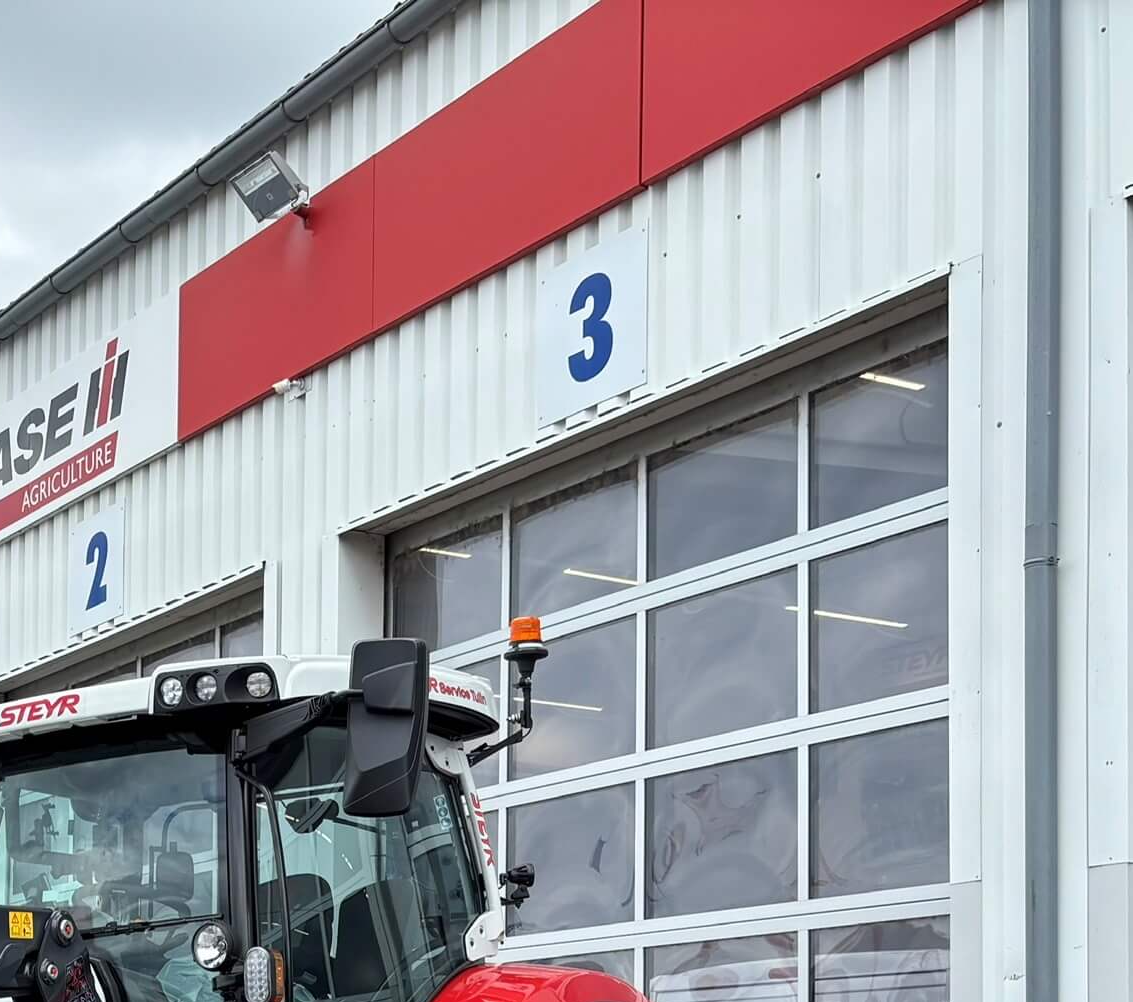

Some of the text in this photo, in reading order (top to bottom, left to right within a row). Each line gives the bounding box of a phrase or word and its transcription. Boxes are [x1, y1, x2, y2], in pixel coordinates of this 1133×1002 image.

[568, 272, 613, 382] 3
[21, 443, 112, 512] AGRICULTURE
[85, 531, 108, 611] 2
